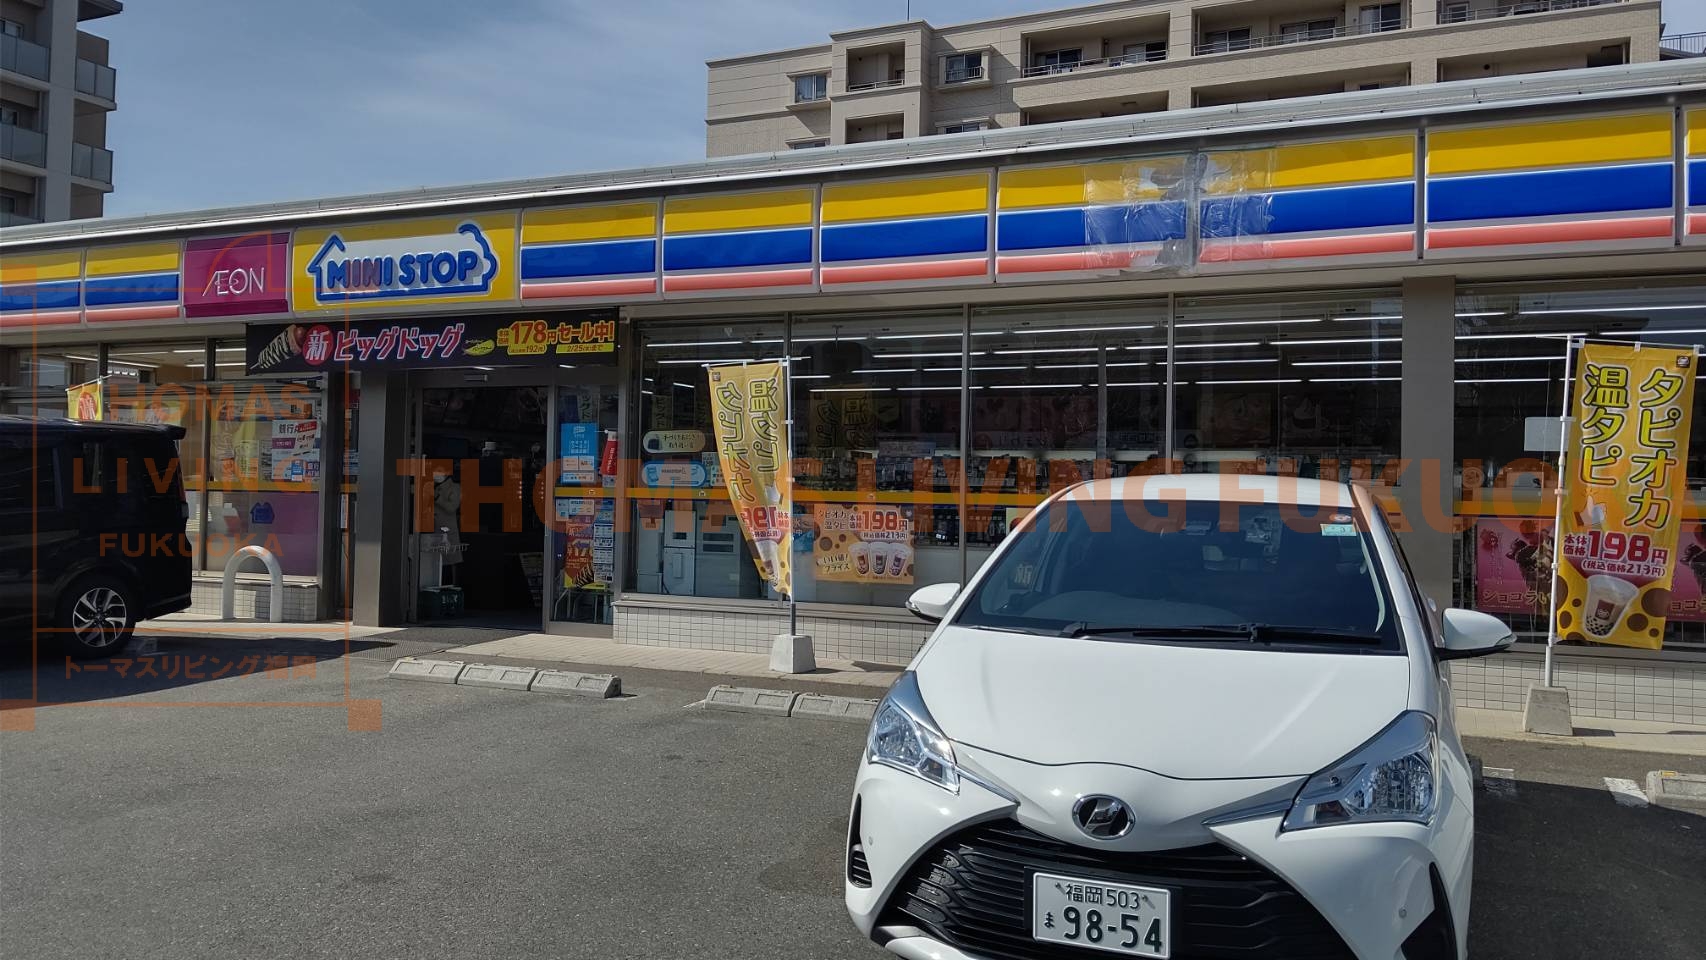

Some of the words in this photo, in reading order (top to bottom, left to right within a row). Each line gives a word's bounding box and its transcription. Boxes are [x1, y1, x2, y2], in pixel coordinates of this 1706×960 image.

[327, 257, 392, 289] MINI
[399, 250, 478, 285] STOP
[305, 330, 330, 361] 新
[334, 323, 465, 362] ビッグドッグ
[1581, 363, 1629, 486] 温タピ
[1624, 368, 1684, 529] タピオカ
[1563, 545, 1586, 556] 価格
[1564, 533, 1587, 544] 本体
[1587, 531, 1668, 565] 198円
[1581, 560, 1666, 576] (税込価格213円)
[1065, 884, 1103, 905] 福岡
[1106, 888, 1140, 910] 503
[1044, 912, 1055, 928] ま
[1063, 906, 1162, 953] 98-54
